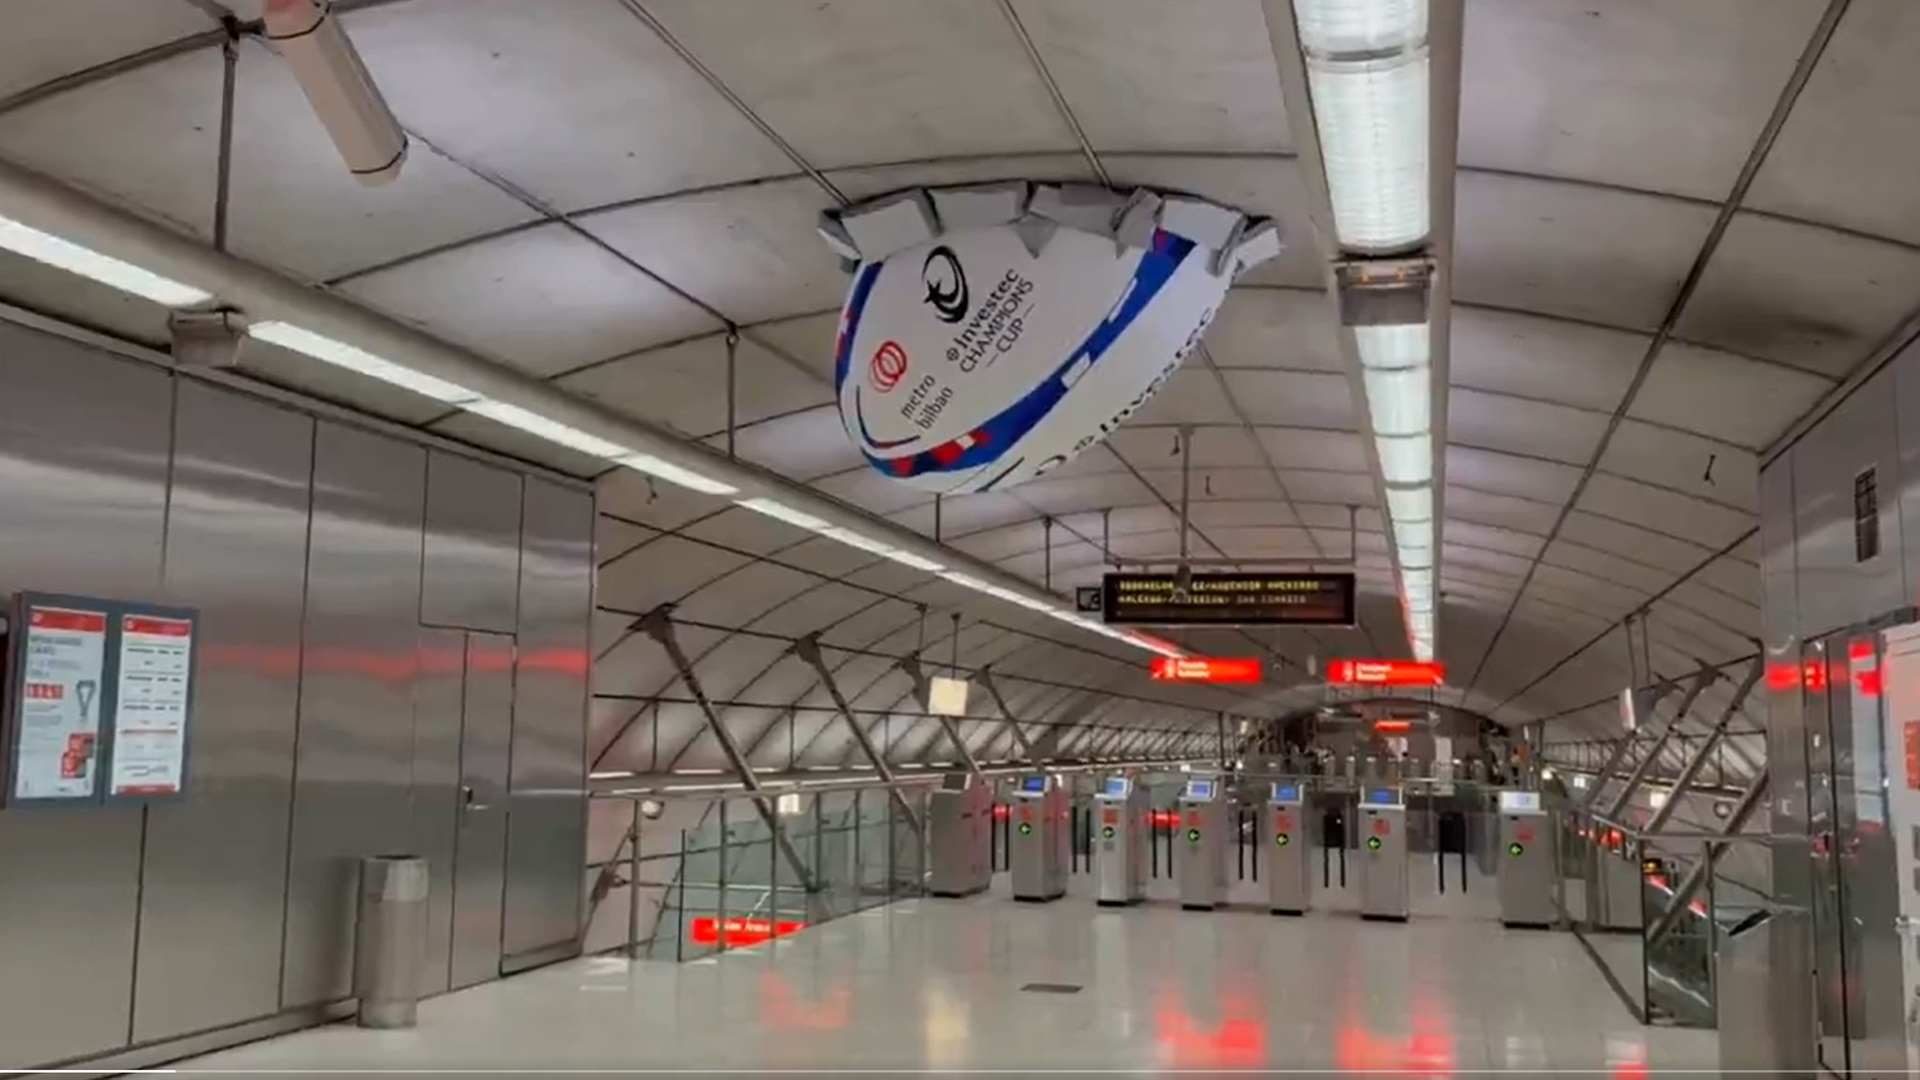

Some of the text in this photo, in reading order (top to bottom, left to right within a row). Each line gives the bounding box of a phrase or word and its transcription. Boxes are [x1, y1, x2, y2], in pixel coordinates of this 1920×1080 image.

[953, 268, 1019, 349] Investec
[960, 278, 1034, 373] CHAMPIONS
[996, 318, 1023, 353] CUP
[901, 375, 936, 419] metro
[914, 387, 954, 430] bilbao
